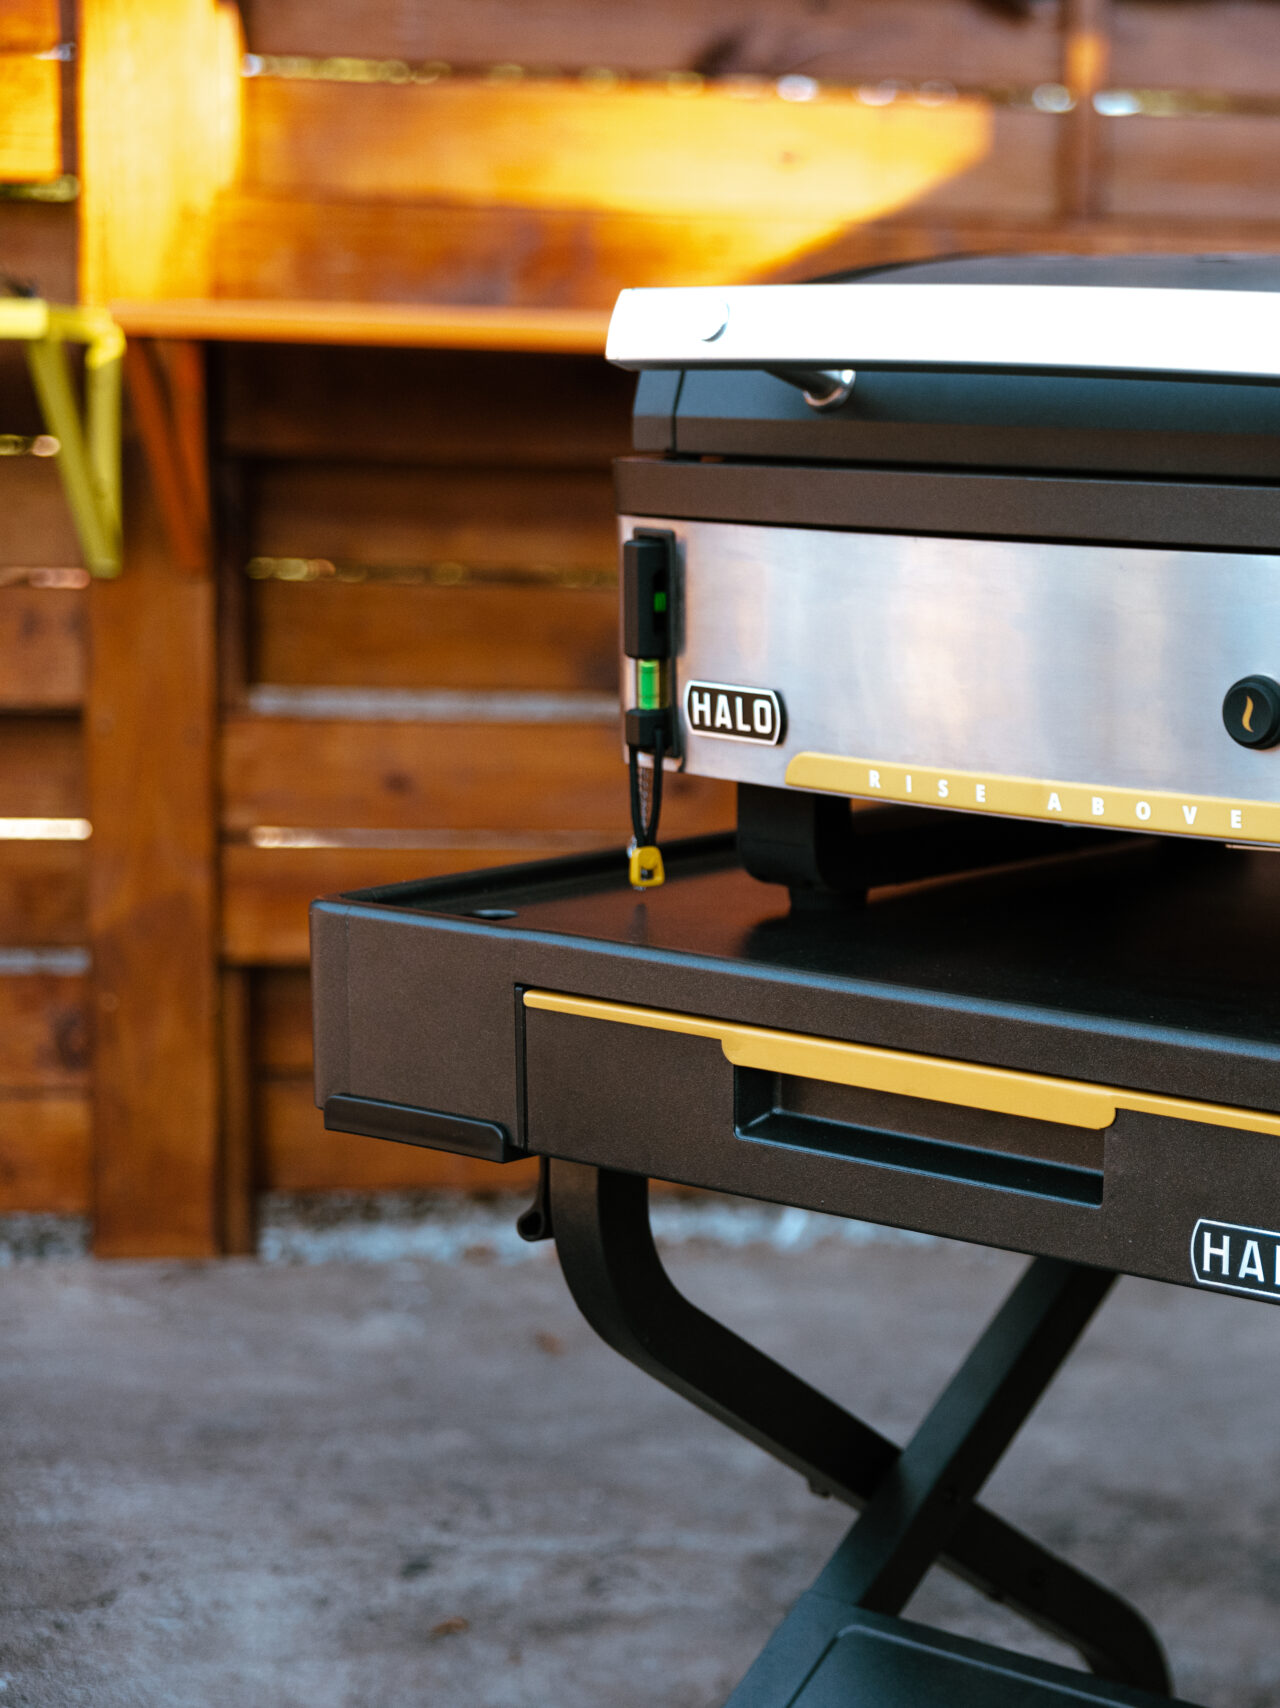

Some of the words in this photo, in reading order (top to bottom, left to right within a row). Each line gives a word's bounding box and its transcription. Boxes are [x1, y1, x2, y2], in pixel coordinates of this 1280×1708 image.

[691, 690, 773, 735] HALO
[868, 769, 986, 803] RISE
[1047, 792, 1242, 829] ABOVE
